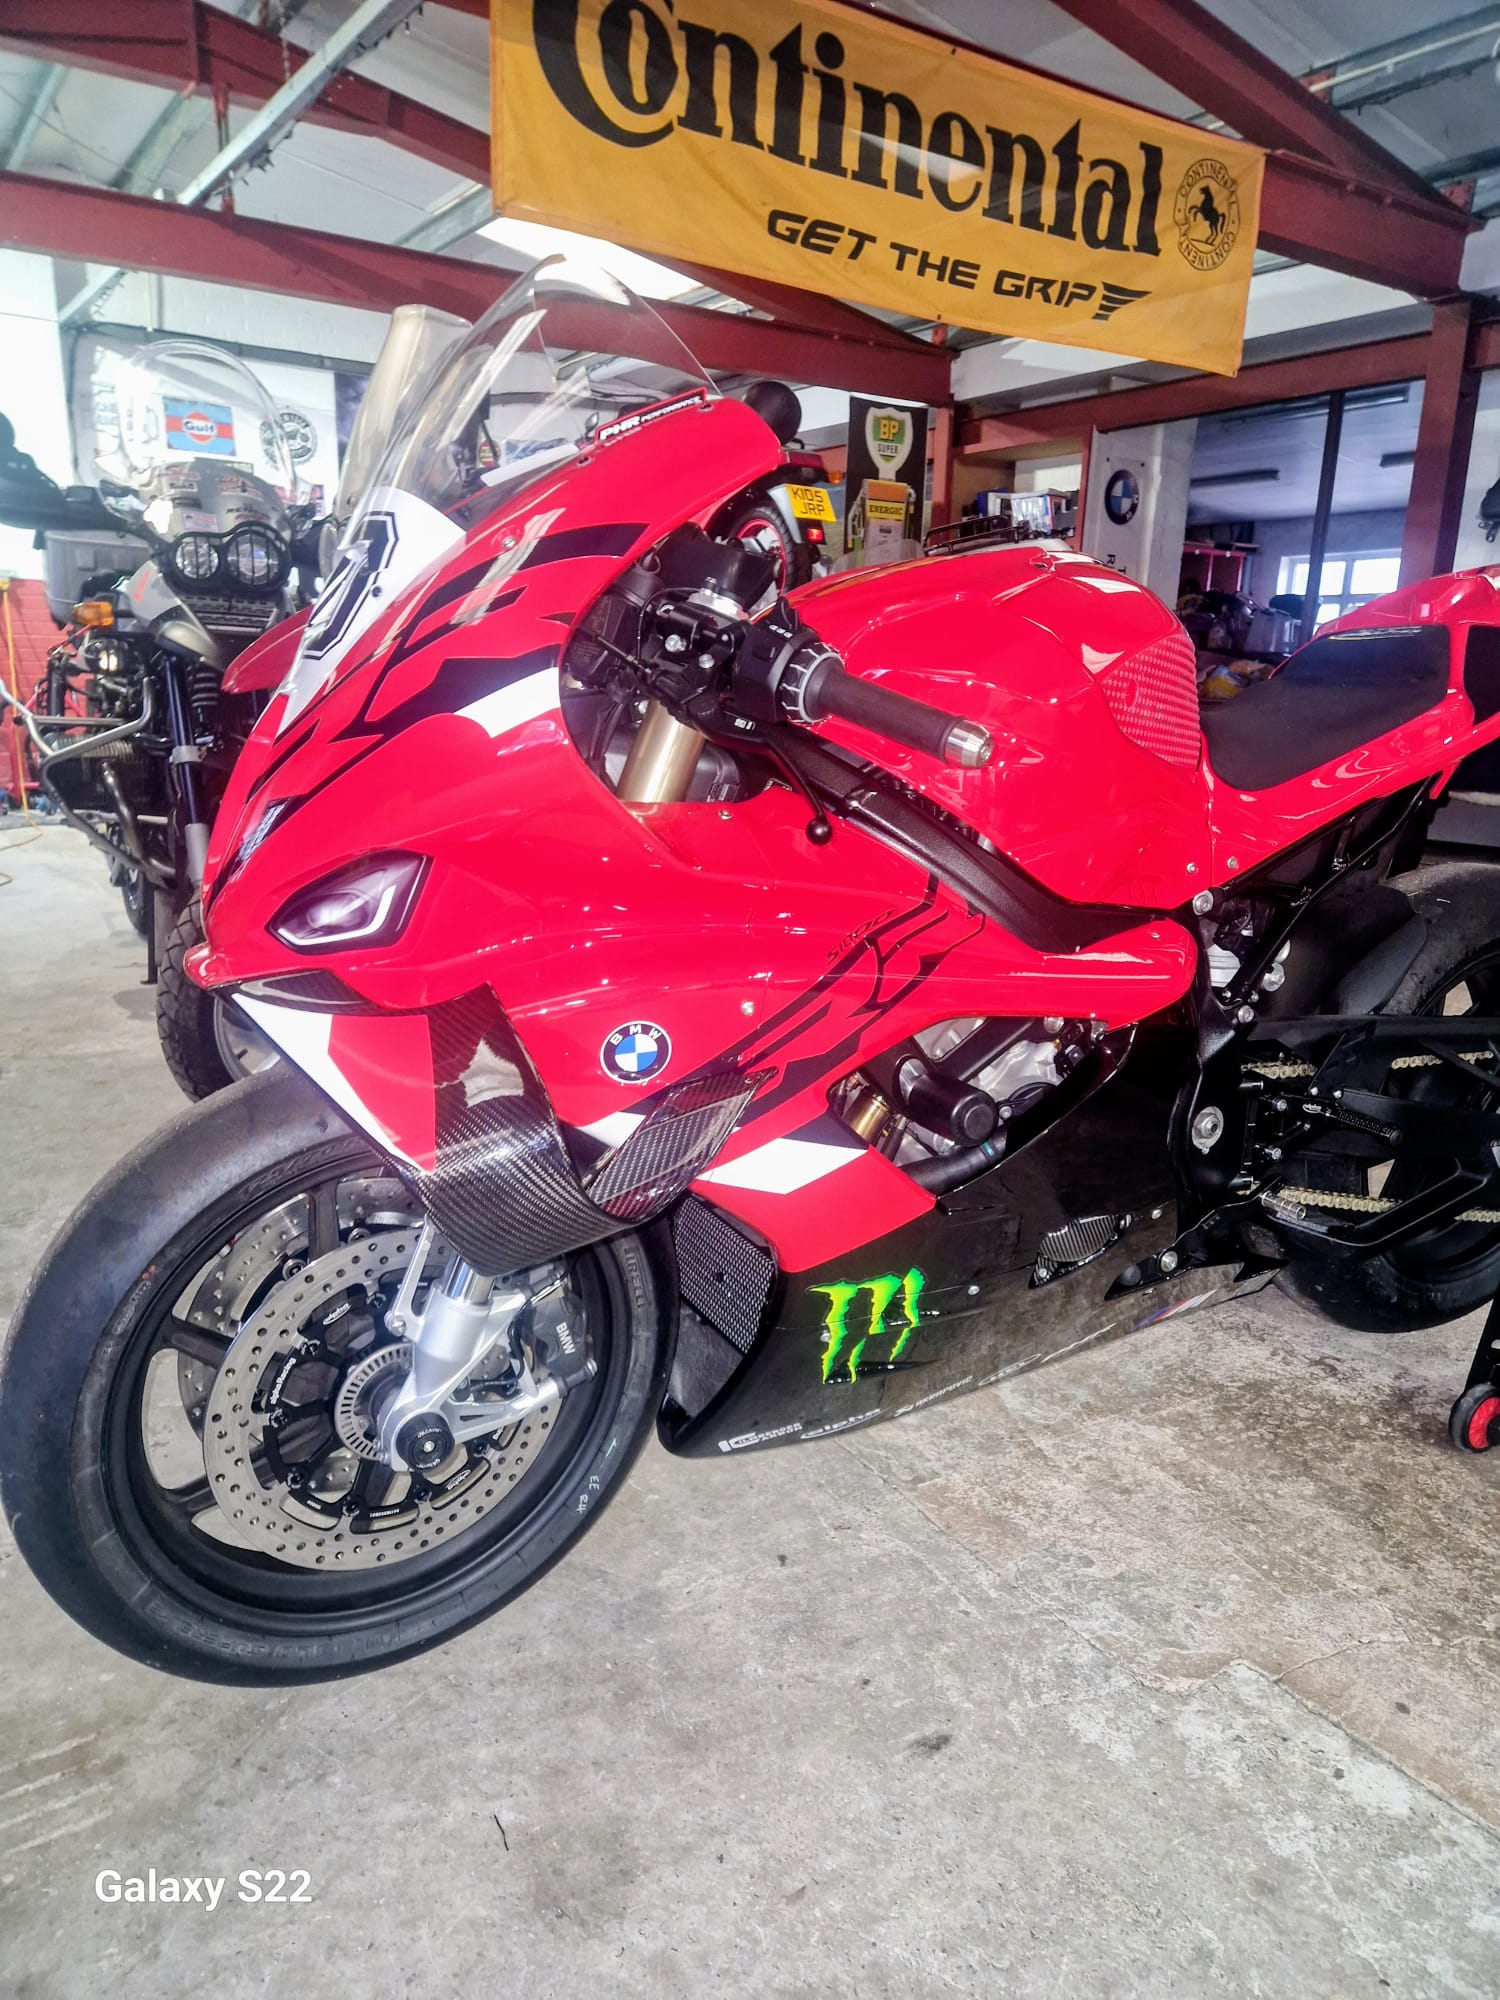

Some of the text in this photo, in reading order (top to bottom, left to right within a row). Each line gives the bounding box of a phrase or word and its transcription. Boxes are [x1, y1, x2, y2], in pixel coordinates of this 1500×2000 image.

[532, 0, 1162, 257] Continental
[767, 209, 1097, 308] GET THE GRIP
[184, 421, 215, 434] Gulf
[880, 419, 899, 440] BP
[878, 442, 899, 455] SUPER
[800, 502, 825, 517] JRP
[609, 1024, 662, 1046] BMW
[556, 1322, 576, 1355] BMW
